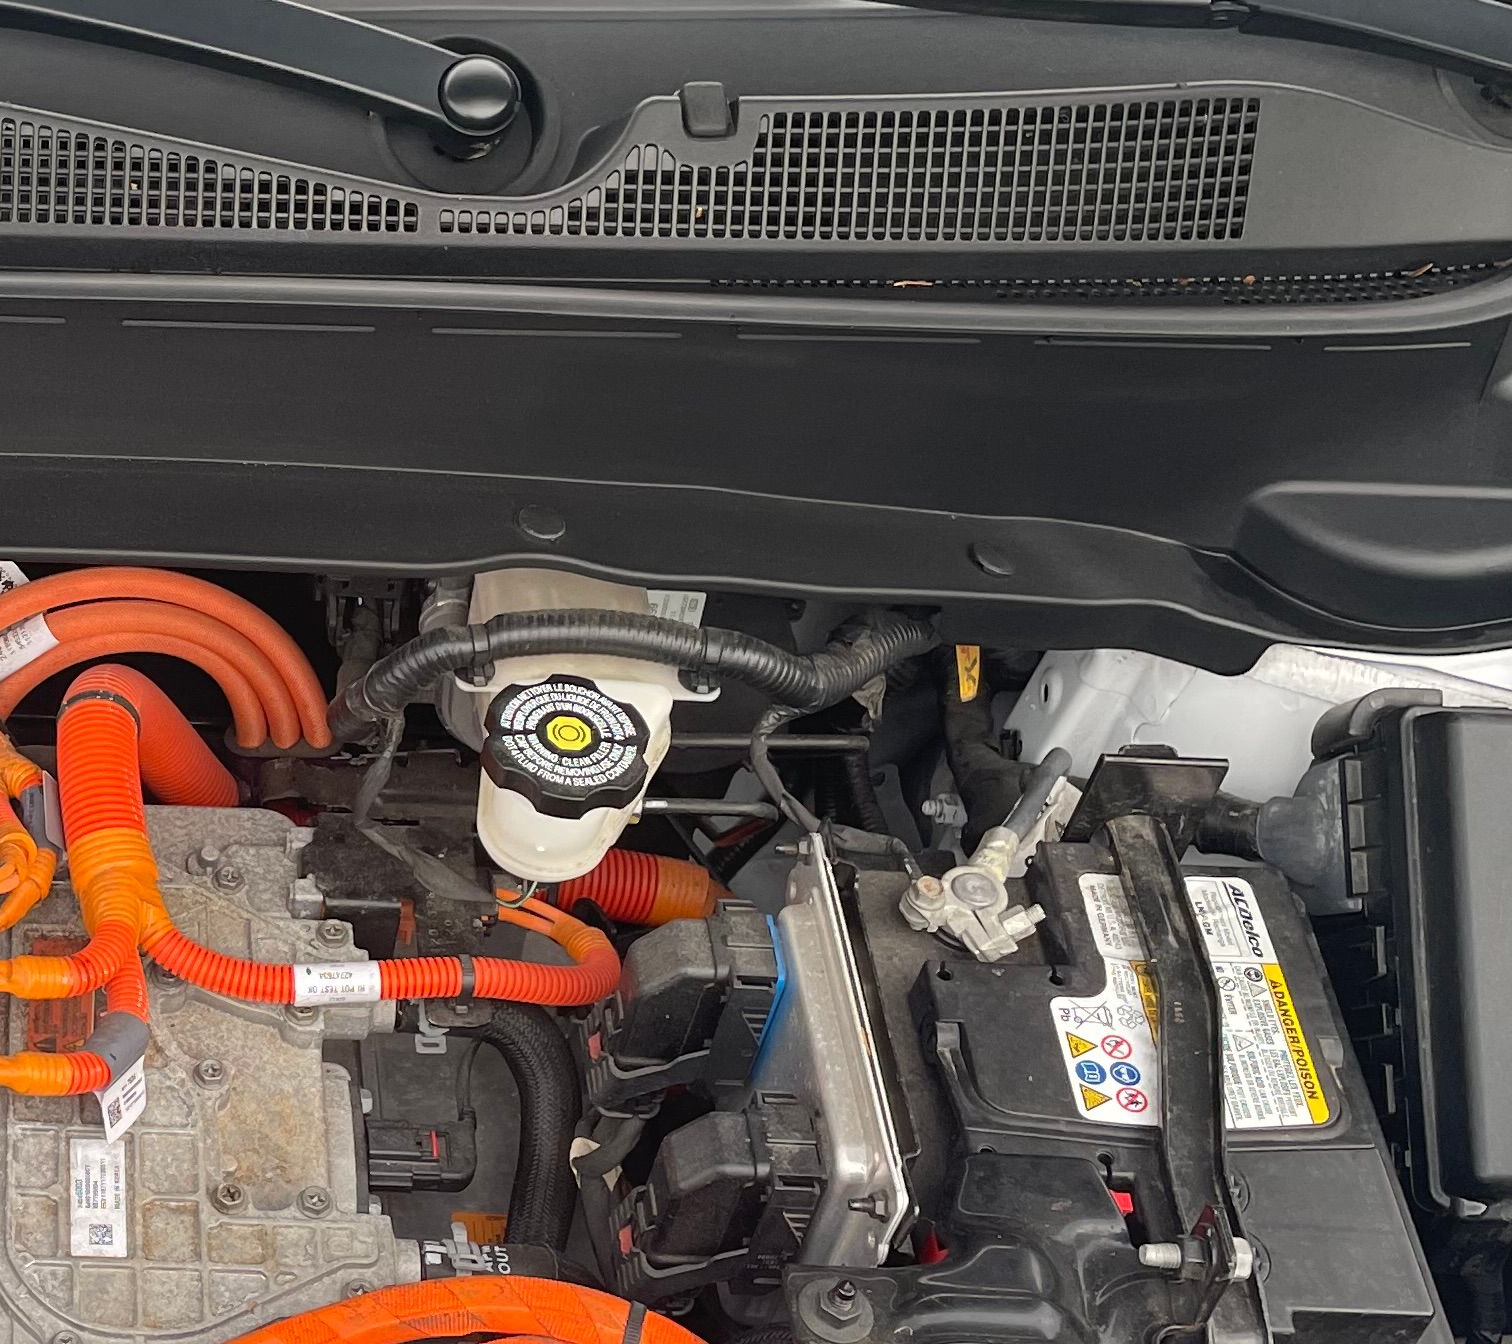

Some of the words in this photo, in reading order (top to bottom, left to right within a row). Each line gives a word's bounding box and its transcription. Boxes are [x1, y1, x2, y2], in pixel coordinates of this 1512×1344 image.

[517, 684, 552, 701] NETTOYER
[554, 683, 563, 691] LE
[515, 735, 525, 749] CAP
[523, 747, 555, 771] BEFORE
[562, 757, 592, 767] CLEAN
[591, 741, 611, 762] FILLER
[515, 755, 538, 773] FLUID
[537, 770, 563, 784] FROM
[564, 776, 572, 786] A
[574, 775, 607, 787] SEALED
[1097, 914, 1112, 947] GERMANY
[1228, 884, 1263, 958] ACDelco
[341, 985, 354, 993] POT
[1060, 1008, 1070, 1022] Pb
[1272, 990, 1319, 1100] DANGER/POISON
[494, 1245, 510, 1274] OUT
